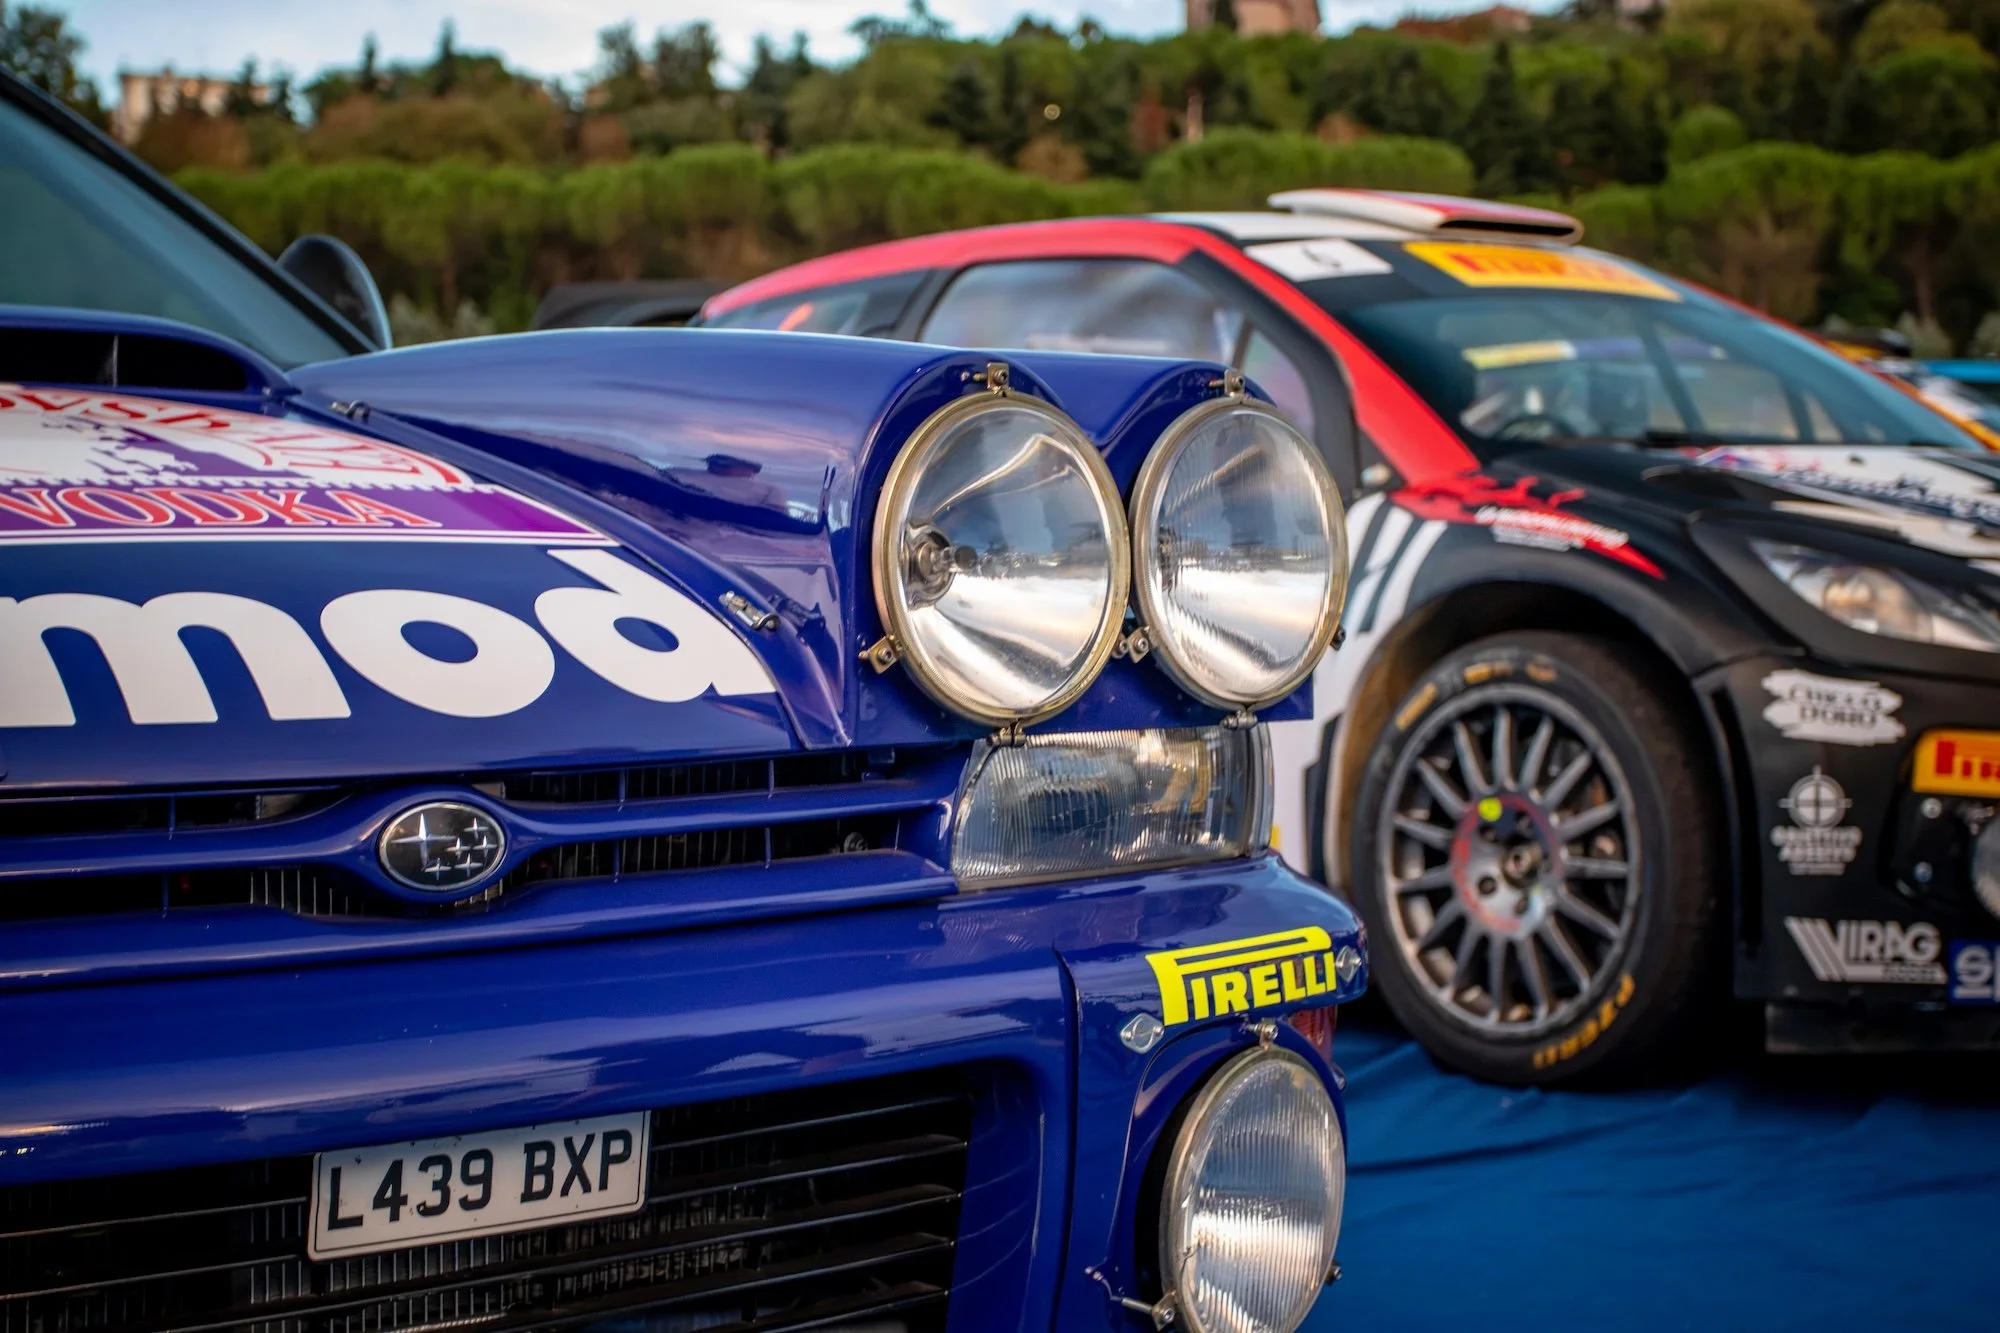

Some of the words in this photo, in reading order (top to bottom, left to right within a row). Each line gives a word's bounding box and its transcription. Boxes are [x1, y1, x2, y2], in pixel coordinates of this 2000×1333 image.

[0, 486, 444, 529] VODKA
[1145, 926, 1336, 1026] PIRELLI
[1784, 916, 1943, 982] VIRAG
[327, 1148, 495, 1231] L439
[520, 1128, 633, 1204] BXP
